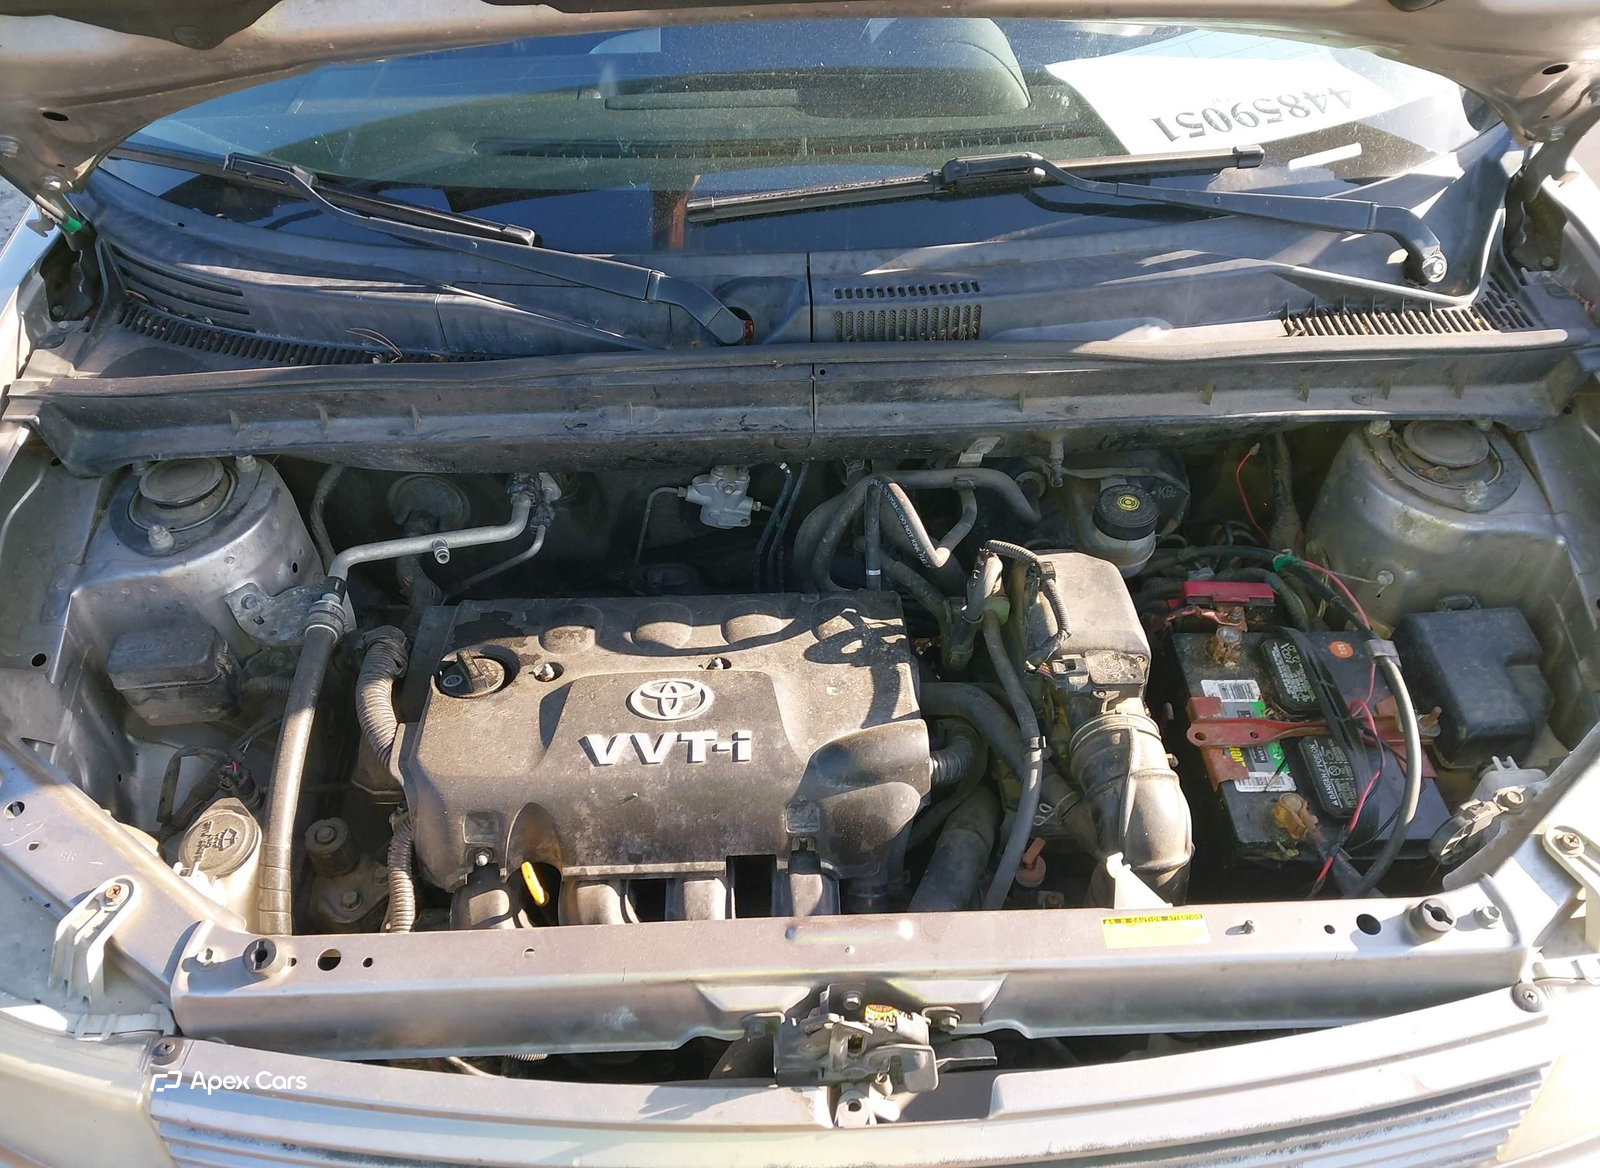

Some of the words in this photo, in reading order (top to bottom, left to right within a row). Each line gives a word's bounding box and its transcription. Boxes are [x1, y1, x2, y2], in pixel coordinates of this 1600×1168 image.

[1149, 87, 1353, 142] 44859051
[578, 730, 752, 767] VVT-i
[1309, 743, 1324, 767] POISON
[1321, 772, 1336, 799] DANGER
[1131, 914, 1162, 923] CAUTION
